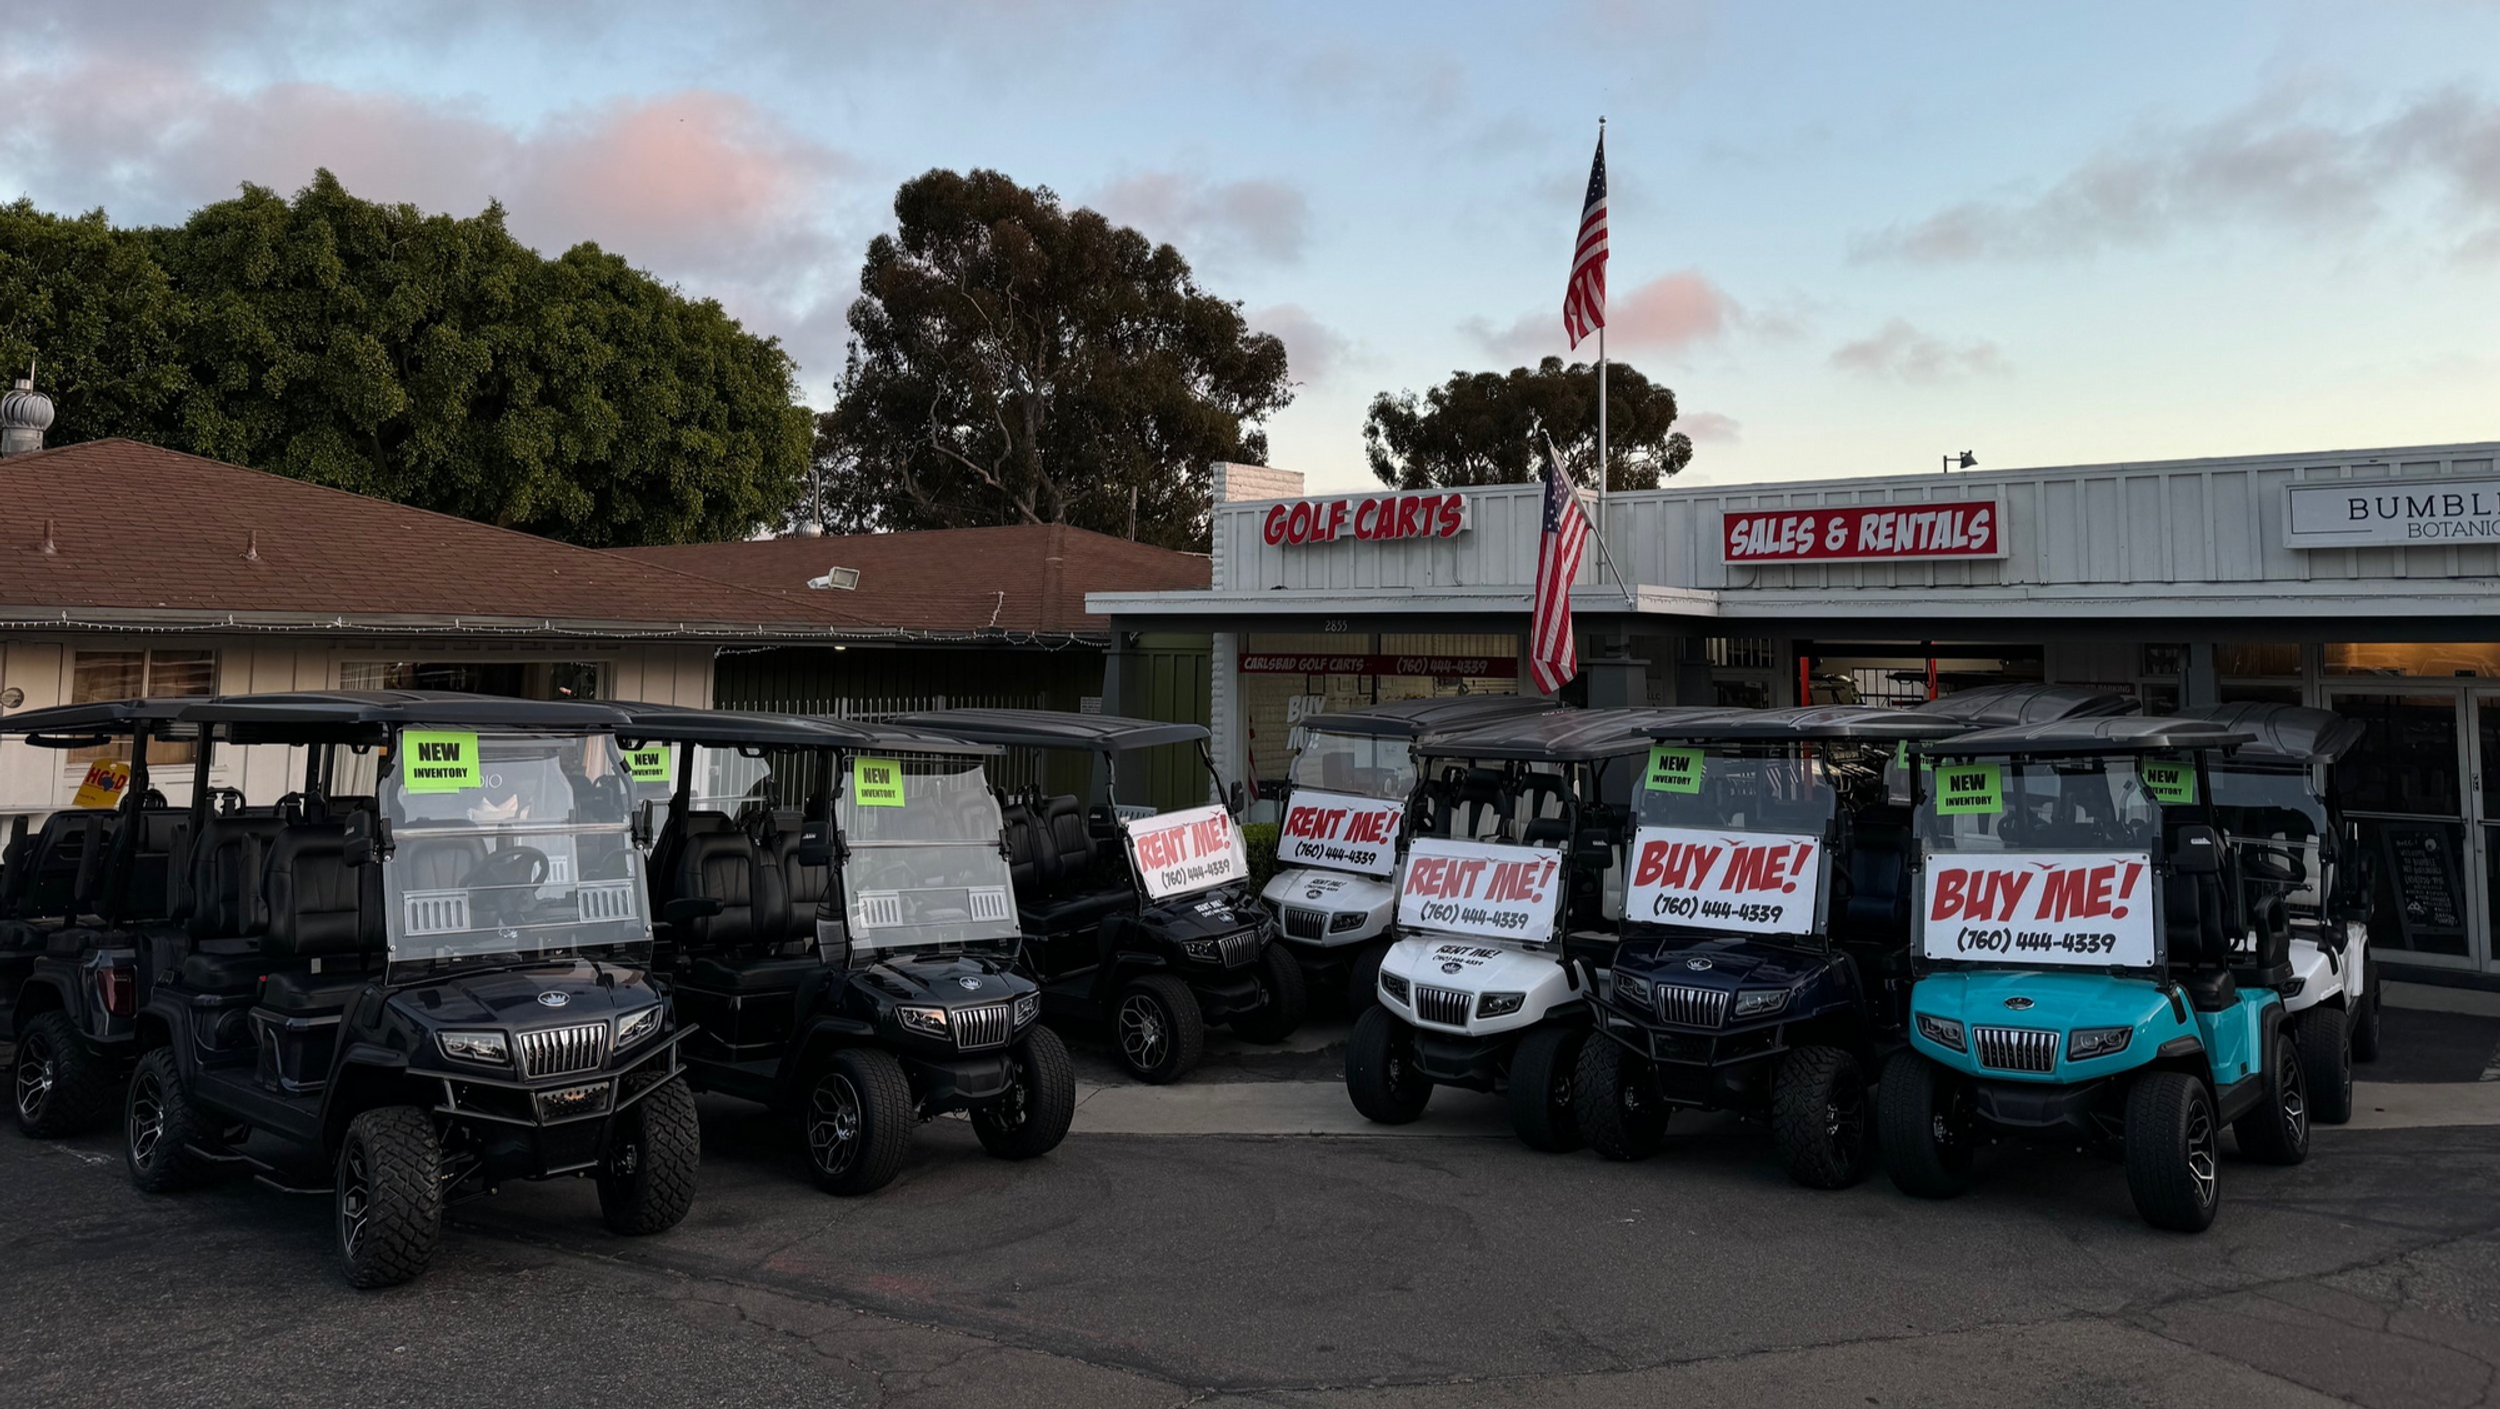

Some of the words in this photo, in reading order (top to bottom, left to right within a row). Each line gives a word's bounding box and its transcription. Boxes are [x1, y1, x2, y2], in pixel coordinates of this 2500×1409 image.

[2348, 493, 2500, 520] BUMBL
[1264, 500, 1350, 546] GOLF
[1354, 493, 1466, 540] CARTS
[1730, 516, 1815, 556] SALES
[1825, 517, 1848, 551] &
[1857, 508, 1990, 553] RENTALS
[1324, 620, 1348, 632] 2855
[1244, 657, 1297, 670] CARLSBAD
[1299, 658, 1327, 671] GOLF
[1329, 658, 1364, 671] CARTS
[1396, 657, 1428, 675] (760)
[1430, 659, 1488, 674] 444-4339
[1286, 695, 1328, 723] BUY
[418, 742, 460, 762] NEW
[634, 753, 659, 766] NEW
[413, 767, 468, 779] INVENTORY
[1658, 755, 1691, 772] NEW
[863, 767, 890, 784] NEW
[1652, 774, 1691, 786] INVENTORY
[1950, 773, 1986, 792] NEW
[2147, 769, 2179, 784] NEW
[861, 788, 896, 799] INVENTORY
[1945, 795, 1992, 807] INVENTORY
[2151, 787, 2182, 796] VENTORY
[1284, 806, 1347, 840] RENT
[1343, 810, 1400, 845] ME!
[1137, 826, 1187, 873] RENT
[1191, 814, 1231, 858] ME!
[1294, 841, 1324, 860] (760)
[1326, 847, 1377, 866] 444-4339
[1161, 866, 1187, 890] (760)
[1187, 858, 1230, 882] 444-4339
[1633, 840, 1723, 891] BUY
[1719, 843, 1814, 894] ME!
[1404, 858, 1487, 900] RENT
[1484, 860, 1557, 903] ME!
[1930, 868, 2034, 923] BUY
[2034, 863, 2143, 923] ME!
[1420, 901, 1460, 924] (760)
[1461, 908, 1529, 930] 444-4339
[1653, 893, 1699, 919] (760)
[1701, 900, 1783, 923] 444-4339
[1957, 926, 2012, 954] (760)
[2016, 931, 2116, 954] 444-4339
